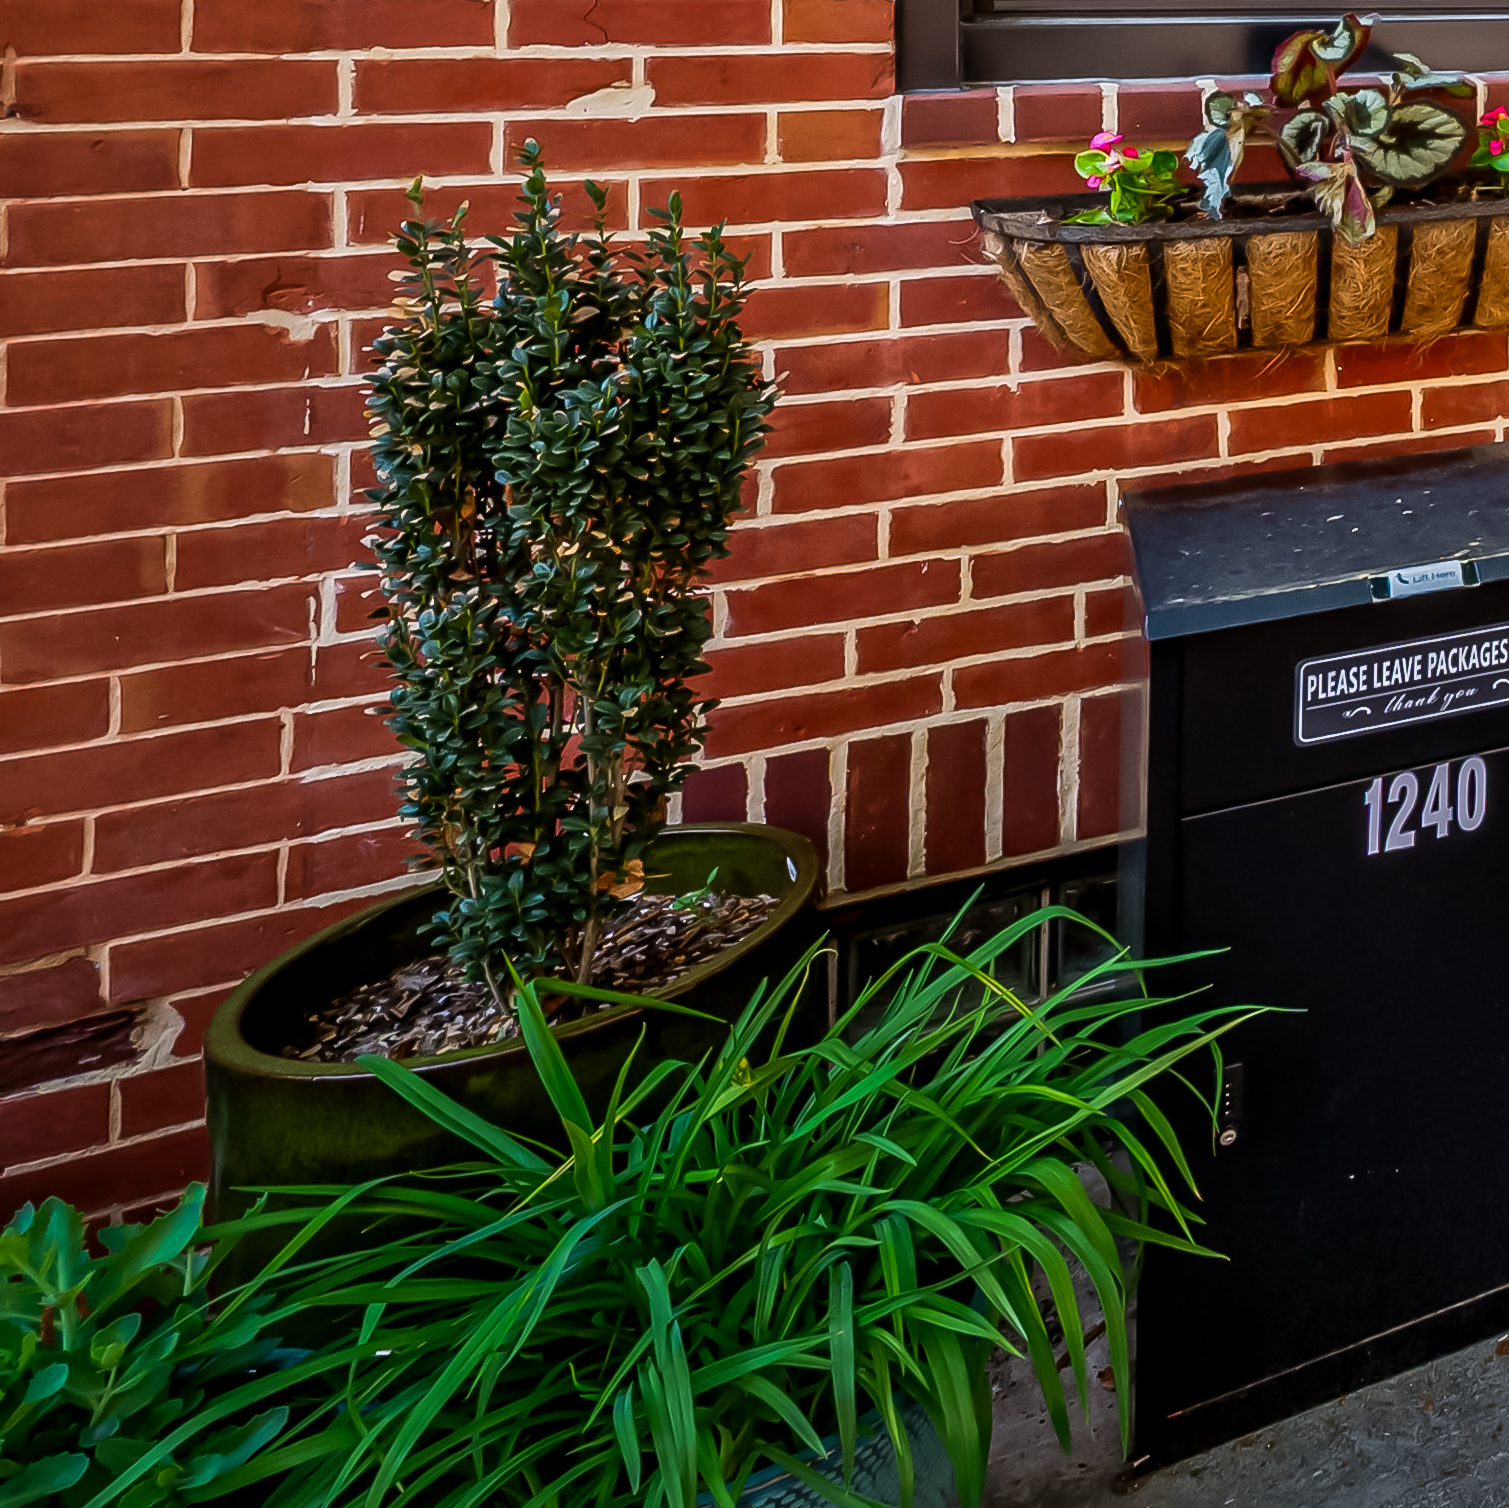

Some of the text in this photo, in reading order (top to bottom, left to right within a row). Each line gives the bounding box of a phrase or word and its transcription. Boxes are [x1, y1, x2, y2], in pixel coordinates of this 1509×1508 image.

[1412, 574, 1429, 584] Lift
[1307, 666, 1368, 701] PLEASE
[1373, 654, 1422, 688] LEAVE
[1427, 638, 1508, 678] PACKAGES
[1383, 687, 1479, 714] thank you
[1363, 755, 1487, 856] 1240
